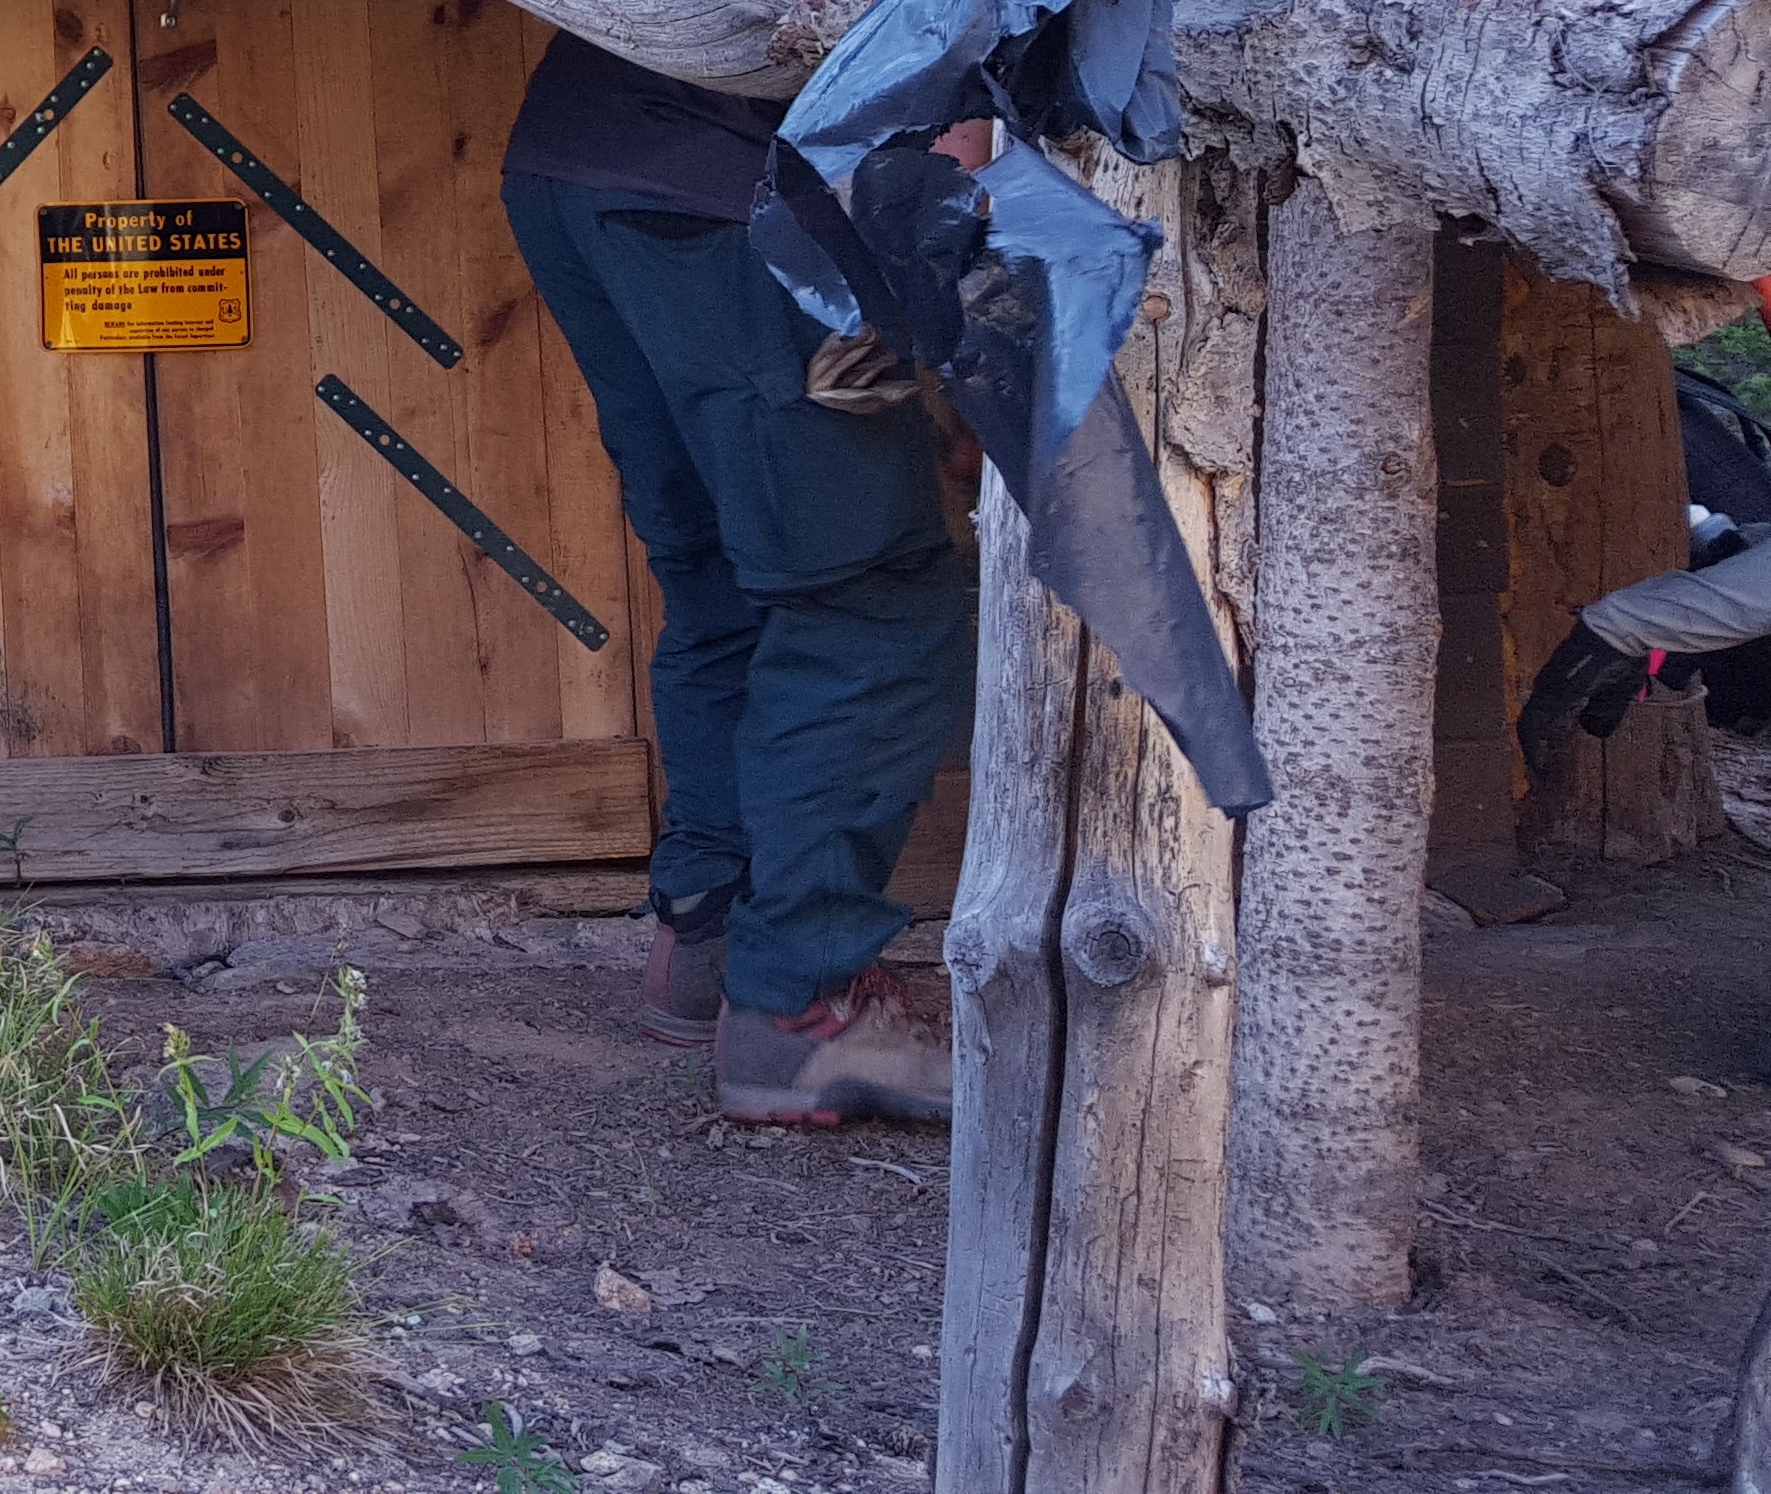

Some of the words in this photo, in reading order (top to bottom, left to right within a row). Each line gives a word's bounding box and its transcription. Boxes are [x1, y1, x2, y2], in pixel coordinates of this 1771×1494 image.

[85, 210, 166, 231] Property
[175, 209, 194, 227] of
[47, 236, 83, 254] THE
[92, 234, 162, 253] UNITED
[169, 232, 242, 251] STATES
[64, 268, 78, 280] All
[81, 270, 120, 282] persons
[123, 270, 140, 279] are
[143, 265, 194, 280] prohibited
[198, 265, 226, 277] under
[64, 283, 103, 298] penalty
[105, 283, 116, 295] of
[119, 283, 135, 295] the
[161, 282, 185, 293] from
[187, 281, 228, 293] commit-
[65, 299, 86, 313] ting
[91, 299, 133, 313] damage
